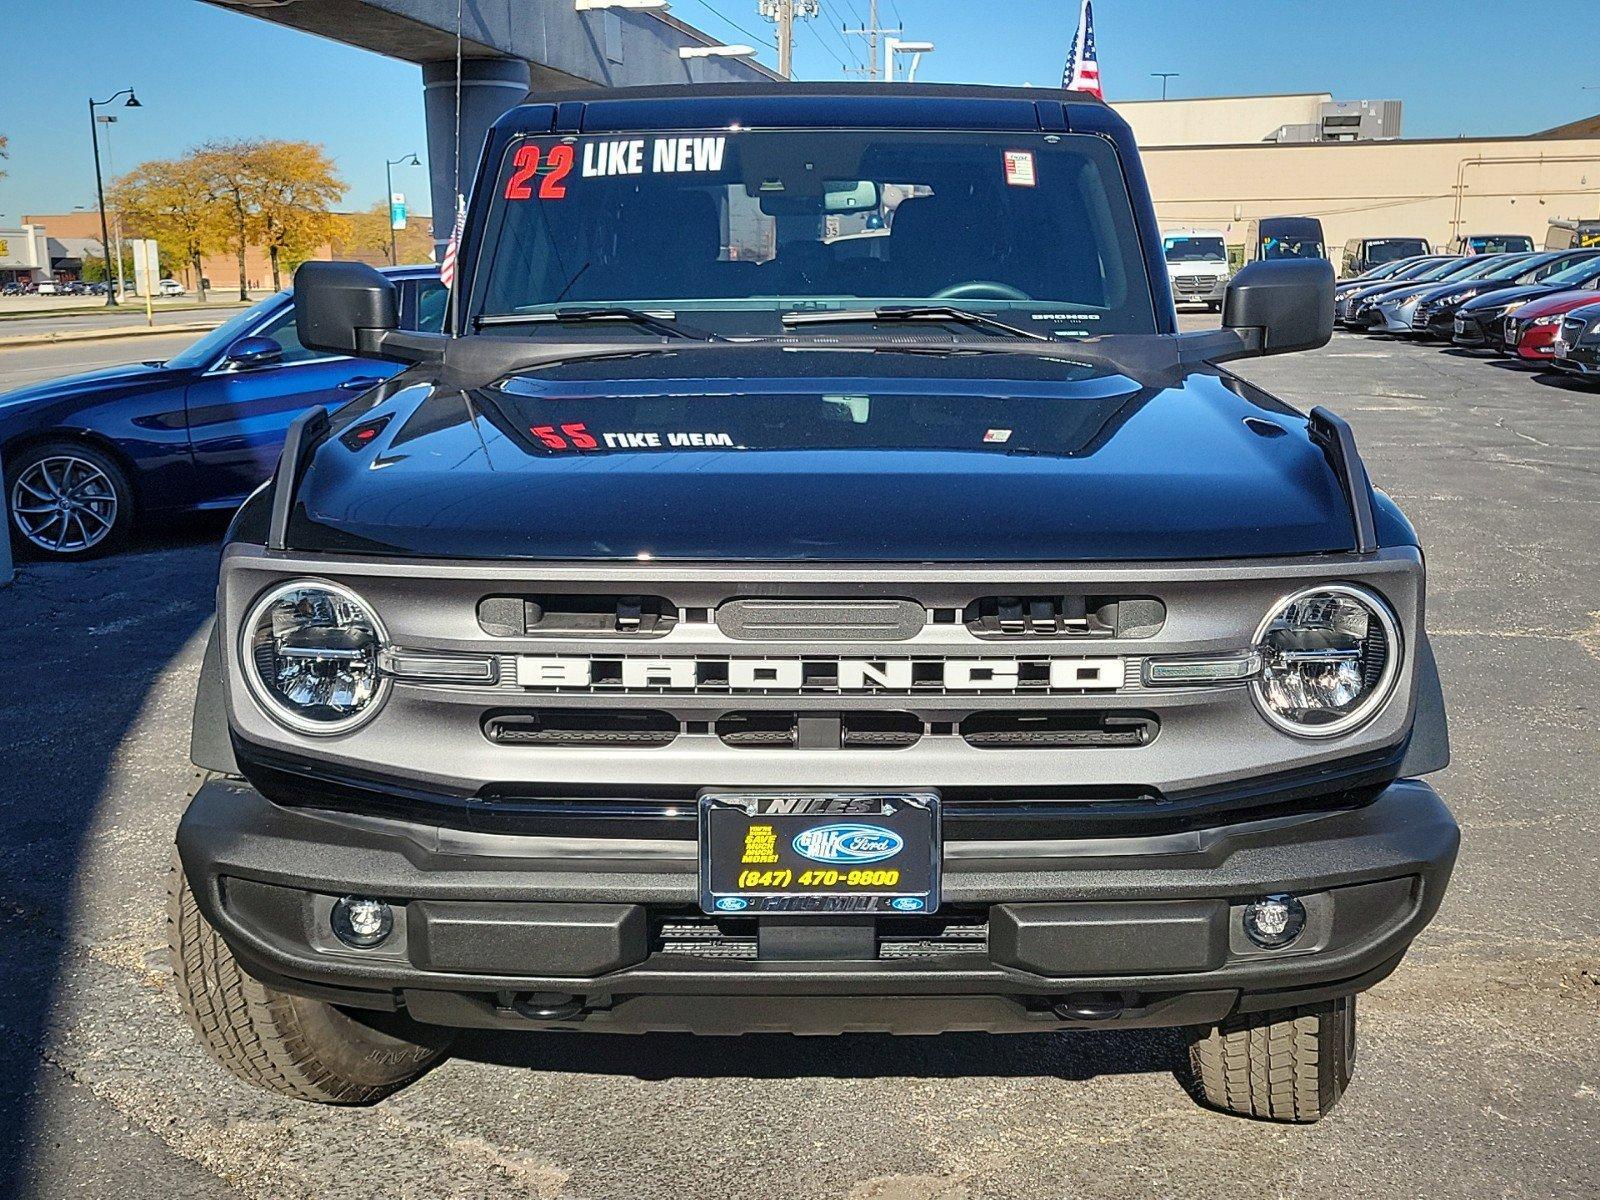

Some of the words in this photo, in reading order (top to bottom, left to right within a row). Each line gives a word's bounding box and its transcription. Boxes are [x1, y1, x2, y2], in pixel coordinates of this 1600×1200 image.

[505, 145, 574, 199] 22
[582, 140, 644, 177] LIKE
[652, 137, 725, 173] NEW
[516, 655, 1126, 691] BRONCO
[766, 798, 874, 814] NILES
[745, 835, 777, 843] SAVE
[801, 831, 839, 846] GOLF
[850, 836, 888, 851] Ford
[808, 844, 838, 857] MILL
[741, 855, 779, 863] MORE!
[738, 870, 792, 888] (847)
[798, 870, 899, 886] 470-9800
